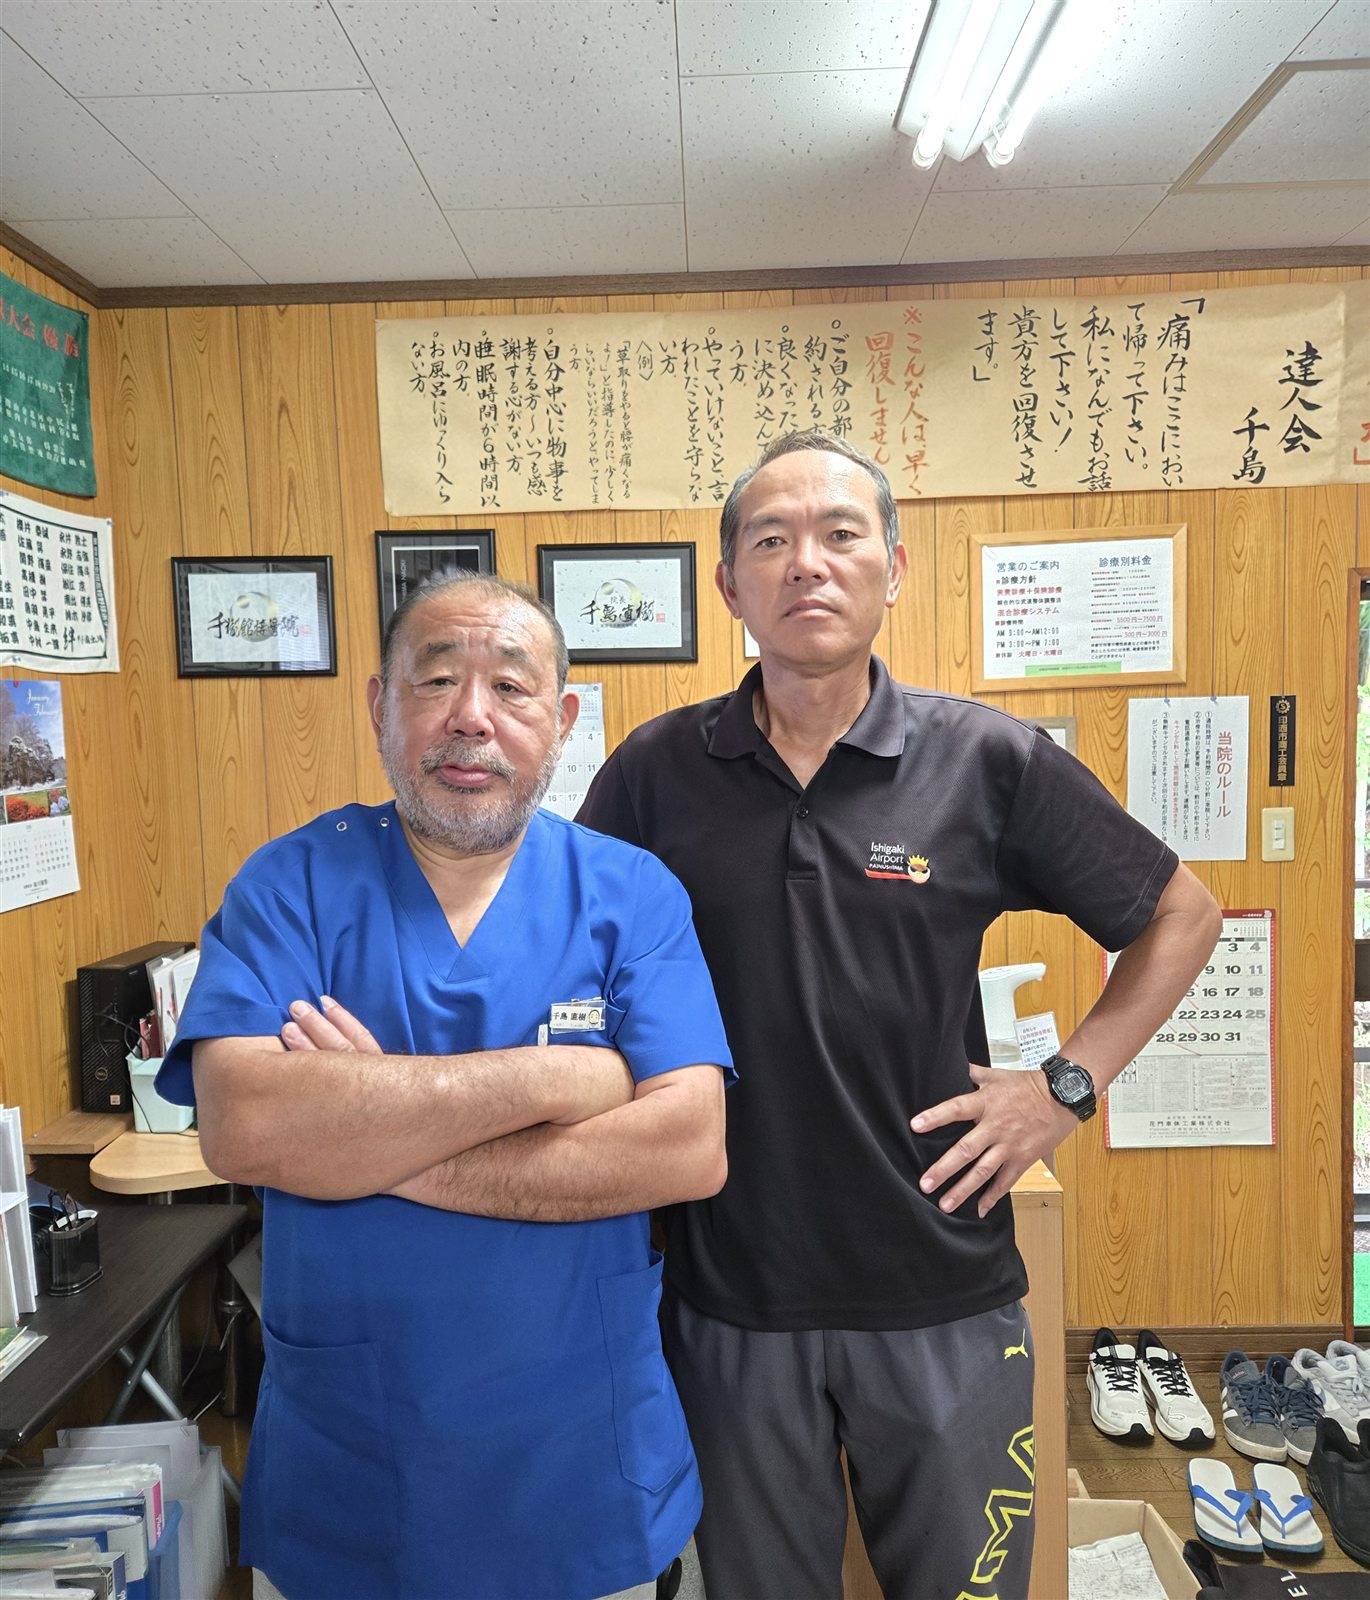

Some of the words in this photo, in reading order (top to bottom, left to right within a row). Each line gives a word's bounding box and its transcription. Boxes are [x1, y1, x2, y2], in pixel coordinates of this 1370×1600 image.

[972, 309, 1000, 382] ます。」
[1121, 302, 1149, 471] て帰って下さい。
[1156, 297, 1206, 487] 「痛みはここにおい
[865, 331, 896, 466] 回復しません
[1007, 309, 1042, 489] 貴方を回復させ
[1277, 340, 1323, 453] 達人会
[681, 336, 704, 502] われたことを守らな
[1232, 406, 1270, 484] 千島
[996, 559, 1060, 573] 営業のご案内
[1099, 555, 1152, 568] 診療別料金
[1001, 575, 1037, 584] 診療方針
[996, 606, 1060, 617] 混合診療システム
[996, 629, 1005, 637] AM
[996, 641, 1005, 649] PM
[588, 733, 593, 741] 4
[588, 764, 596, 772] 11
[1216, 731, 1232, 819] 当院のルール
[568, 794, 577, 802] 17
[871, 842, 905, 854] Ishigaki
[870, 853, 904, 864] Airport
[1228, 942, 1238, 952] 3
[1250, 942, 1261, 951] 4
[1204, 965, 1215, 975] 9
[1224, 965, 1241, 975] 10
[1248, 965, 1264, 975] 11
[1202, 988, 1218, 997] 16
[1224, 987, 1241, 997] 17
[1248, 987, 1264, 997] 18
[1178, 1010, 1197, 1020] 22
[1200, 1010, 1220, 1020] 23
[1222, 1009, 1243, 1020] 24
[1245, 1009, 1266, 1019] 25
[1156, 1033, 1176, 1043] 28
[1178, 1033, 1197, 1042] 29
[1200, 1032, 1220, 1042] 30
[1224, 1032, 1241, 1042] 31
